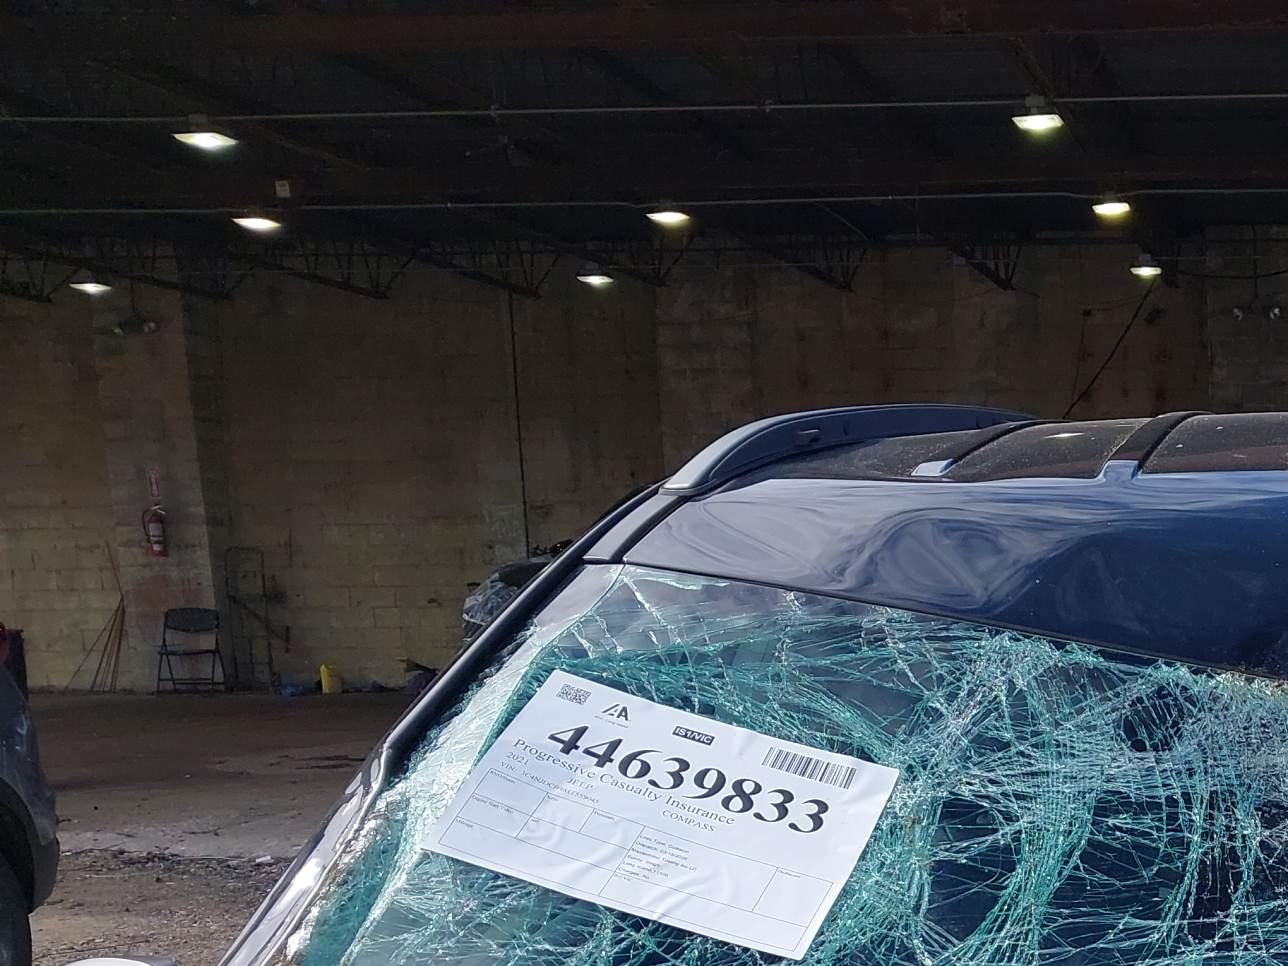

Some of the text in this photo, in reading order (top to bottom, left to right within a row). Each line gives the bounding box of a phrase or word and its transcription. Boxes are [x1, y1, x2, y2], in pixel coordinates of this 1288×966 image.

[505, 751, 529, 766] 2021
[513, 738, 596, 778] Progressive
[600, 772, 662, 802] Casualty
[665, 796, 735, 825] Insurance
[548, 725, 830, 833] 44639833
[662, 809, 716, 832] COMPASS
